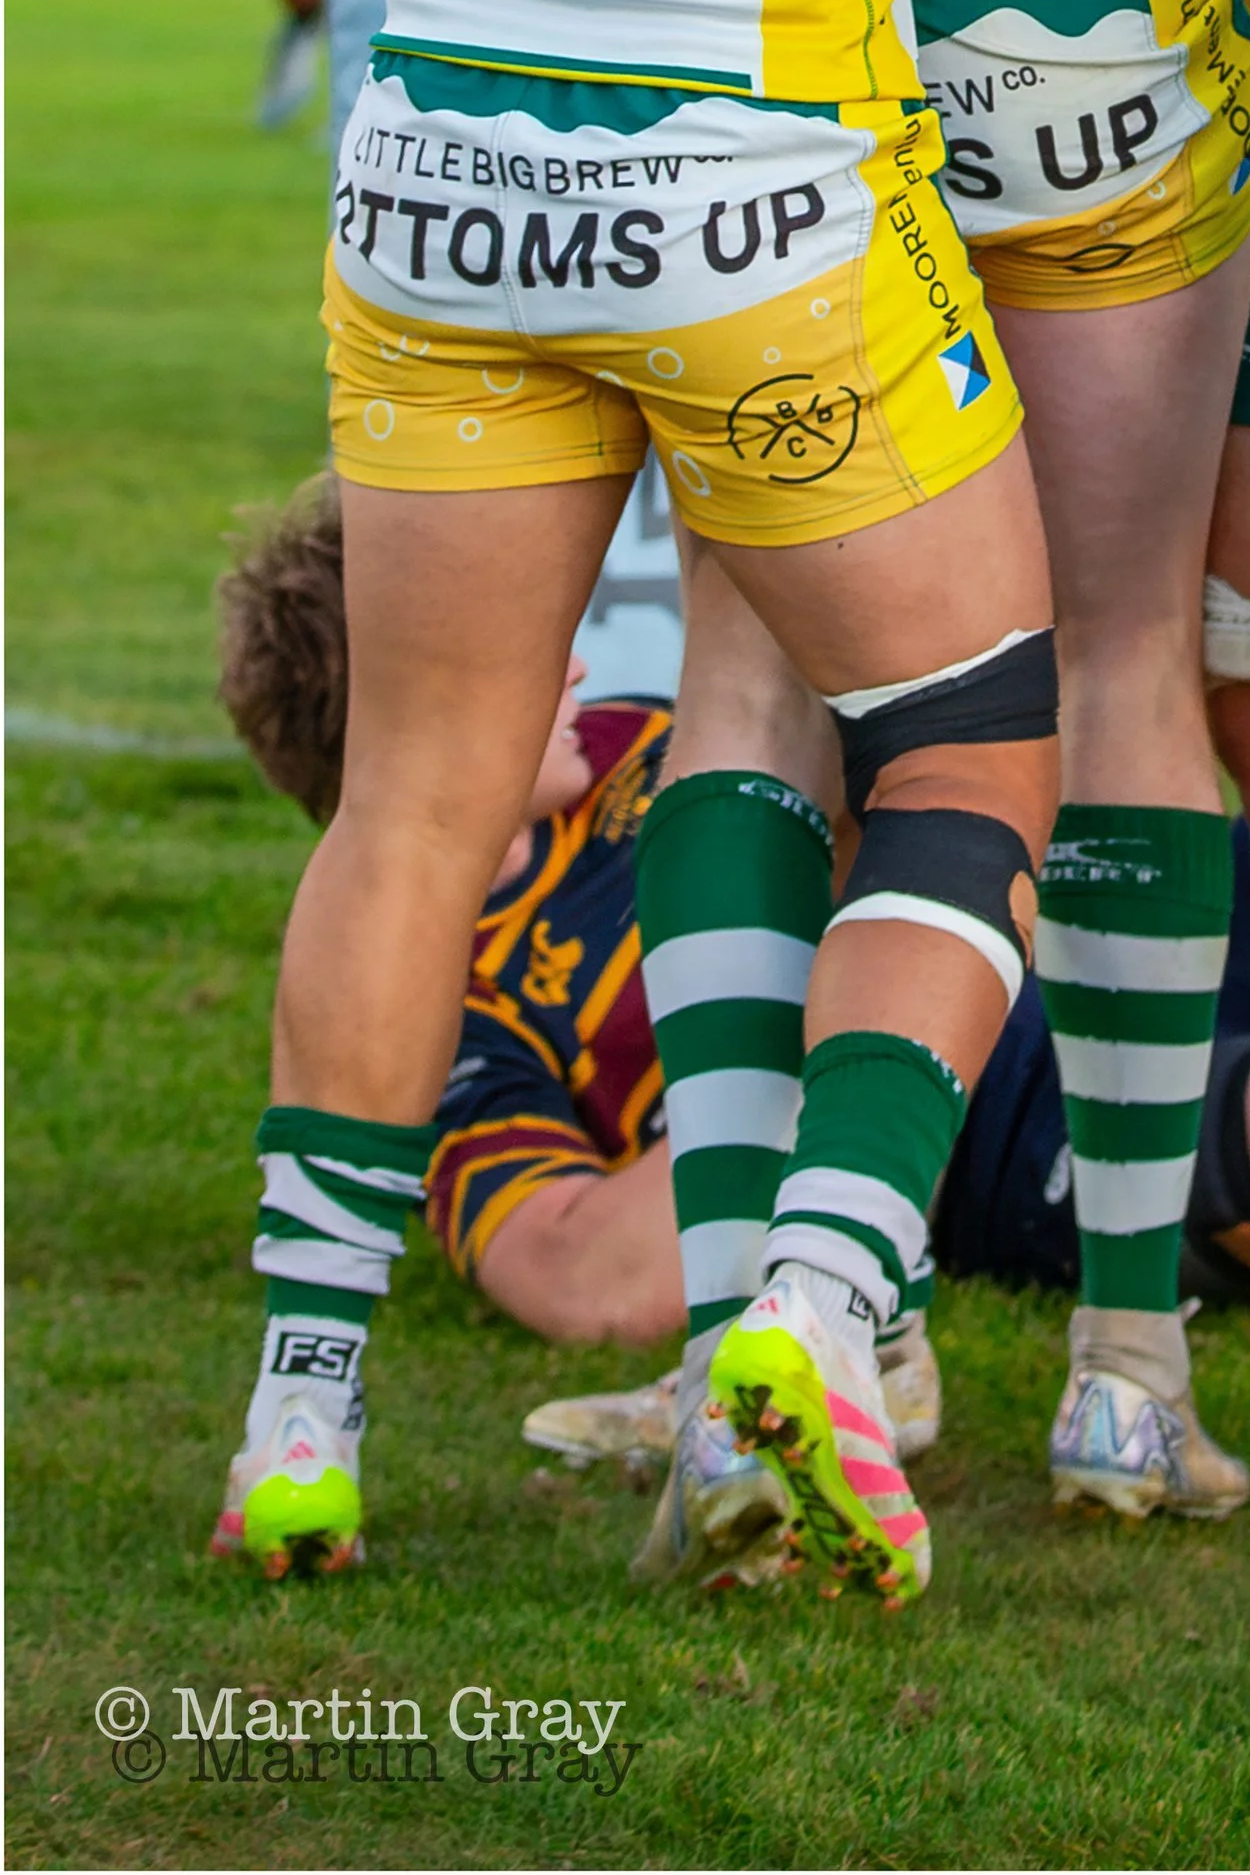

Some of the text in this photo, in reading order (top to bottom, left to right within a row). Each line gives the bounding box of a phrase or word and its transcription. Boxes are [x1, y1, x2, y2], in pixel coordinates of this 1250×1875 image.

[1002, 65, 1046, 91] CO.
[1036, 103, 1158, 191] UP
[335, 180, 826, 289] OTTOMS UP
[279, 1336, 352, 1379] FS
